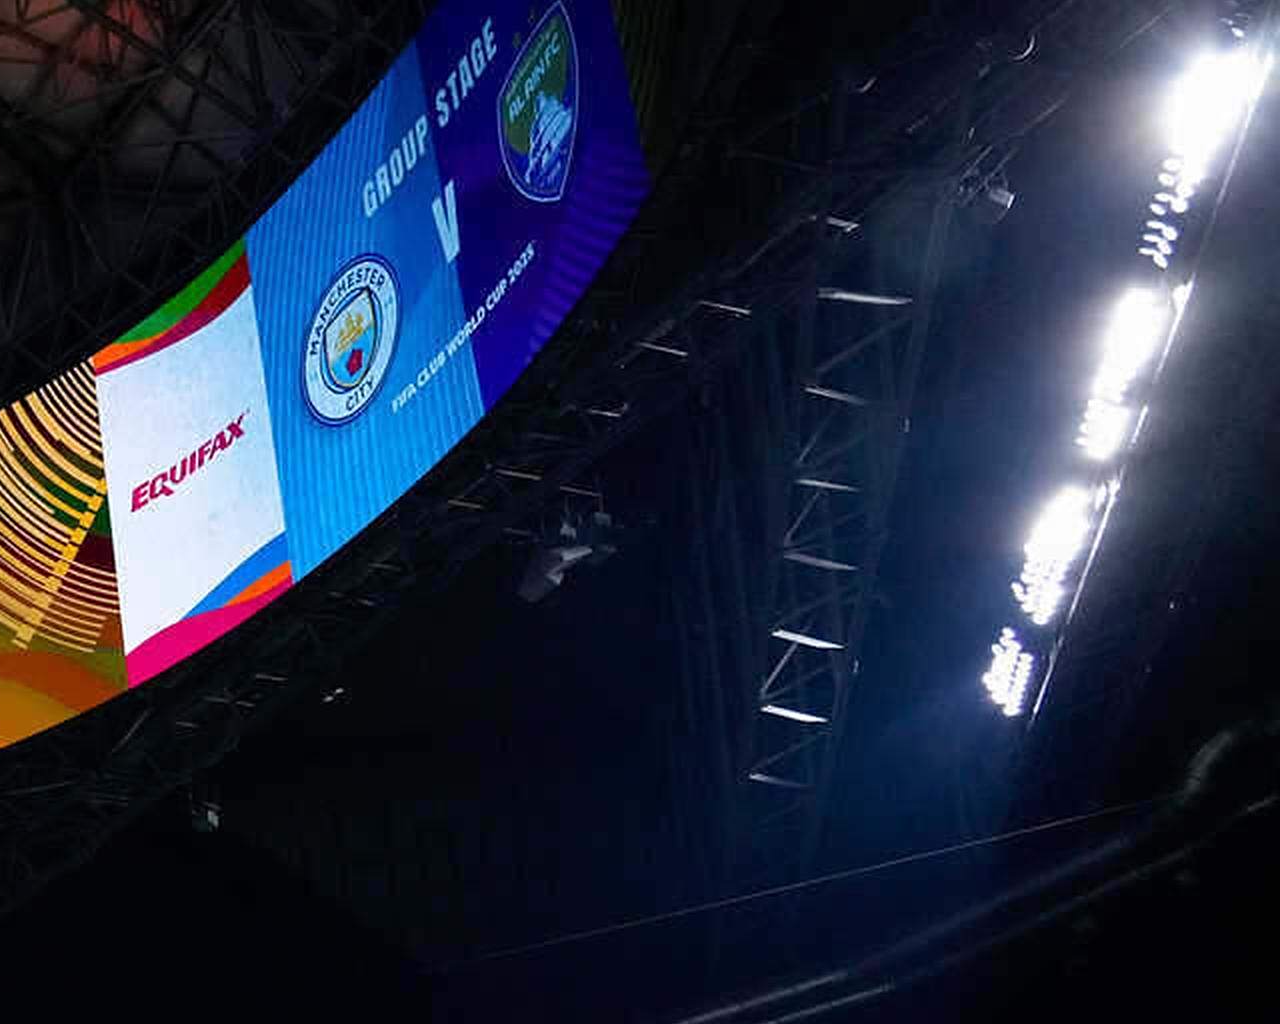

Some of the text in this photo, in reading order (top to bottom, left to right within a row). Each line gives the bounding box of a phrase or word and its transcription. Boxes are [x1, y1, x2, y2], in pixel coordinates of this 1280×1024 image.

[362, 16, 498, 219] GROUP STAGE
[432, 179, 460, 264] V
[309, 267, 386, 356] MANCHESTER
[346, 377, 376, 412] CITY
[130, 413, 246, 512] EQUIFAX
